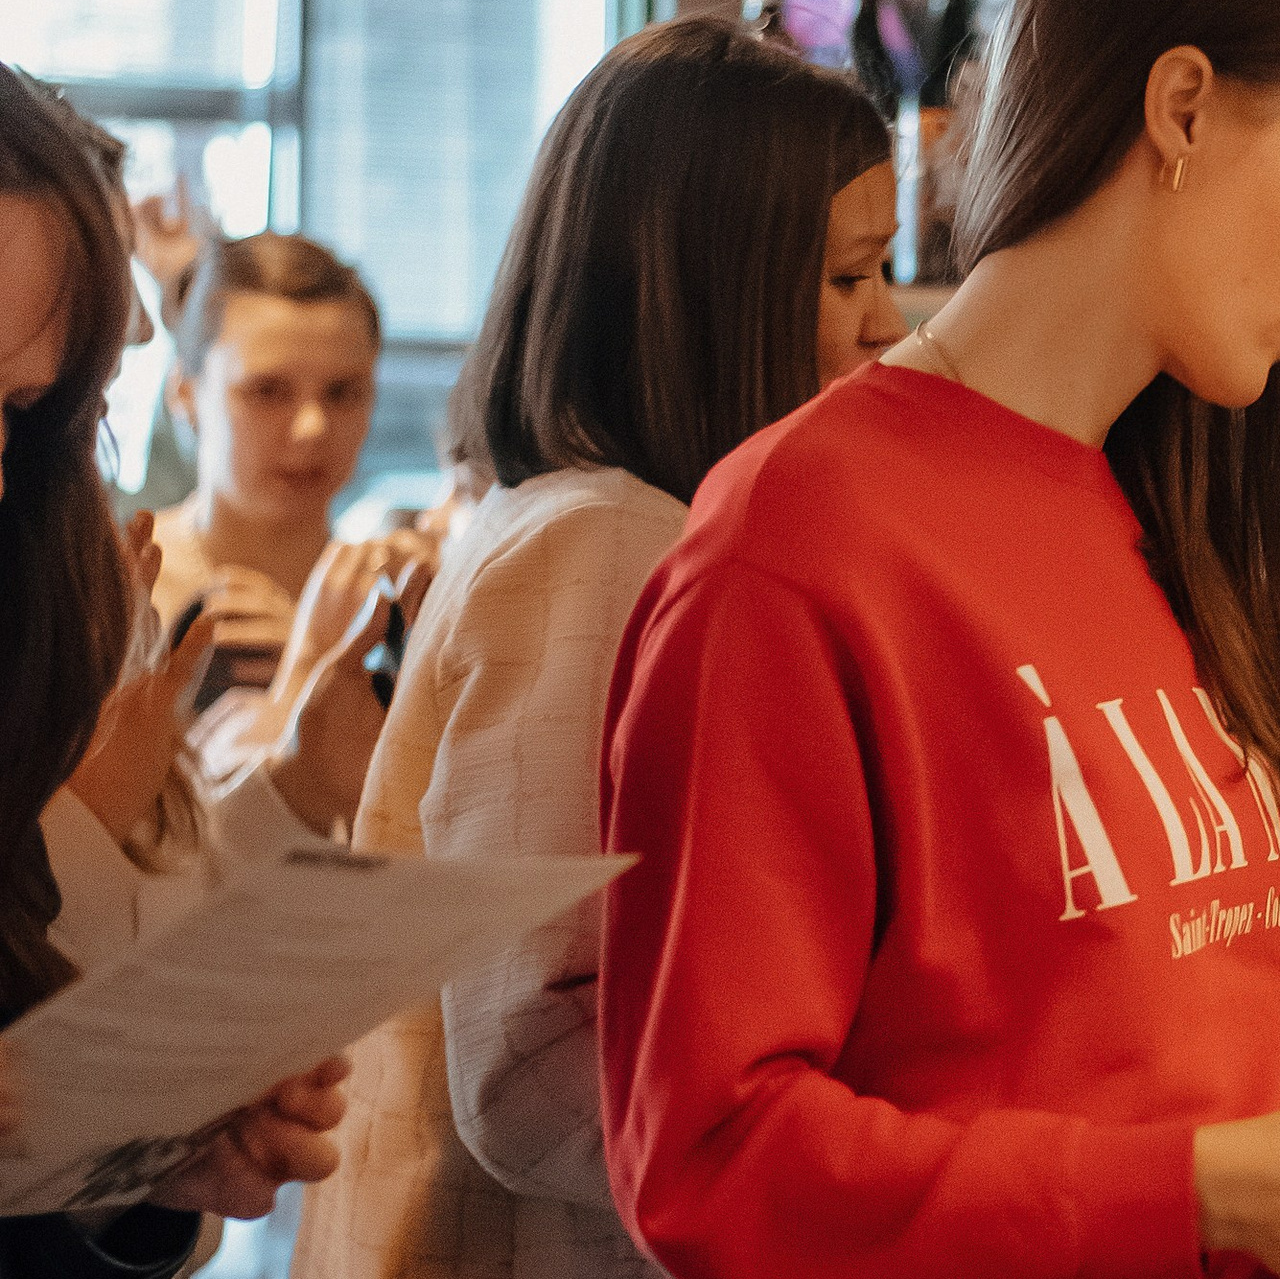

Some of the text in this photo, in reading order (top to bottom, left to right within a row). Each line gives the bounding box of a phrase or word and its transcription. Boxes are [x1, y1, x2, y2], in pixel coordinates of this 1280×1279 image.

[1016, 664, 1139, 922] À
[1096, 687, 1249, 886] LA
[1169, 899, 1255, 959] Saint-Tropez
